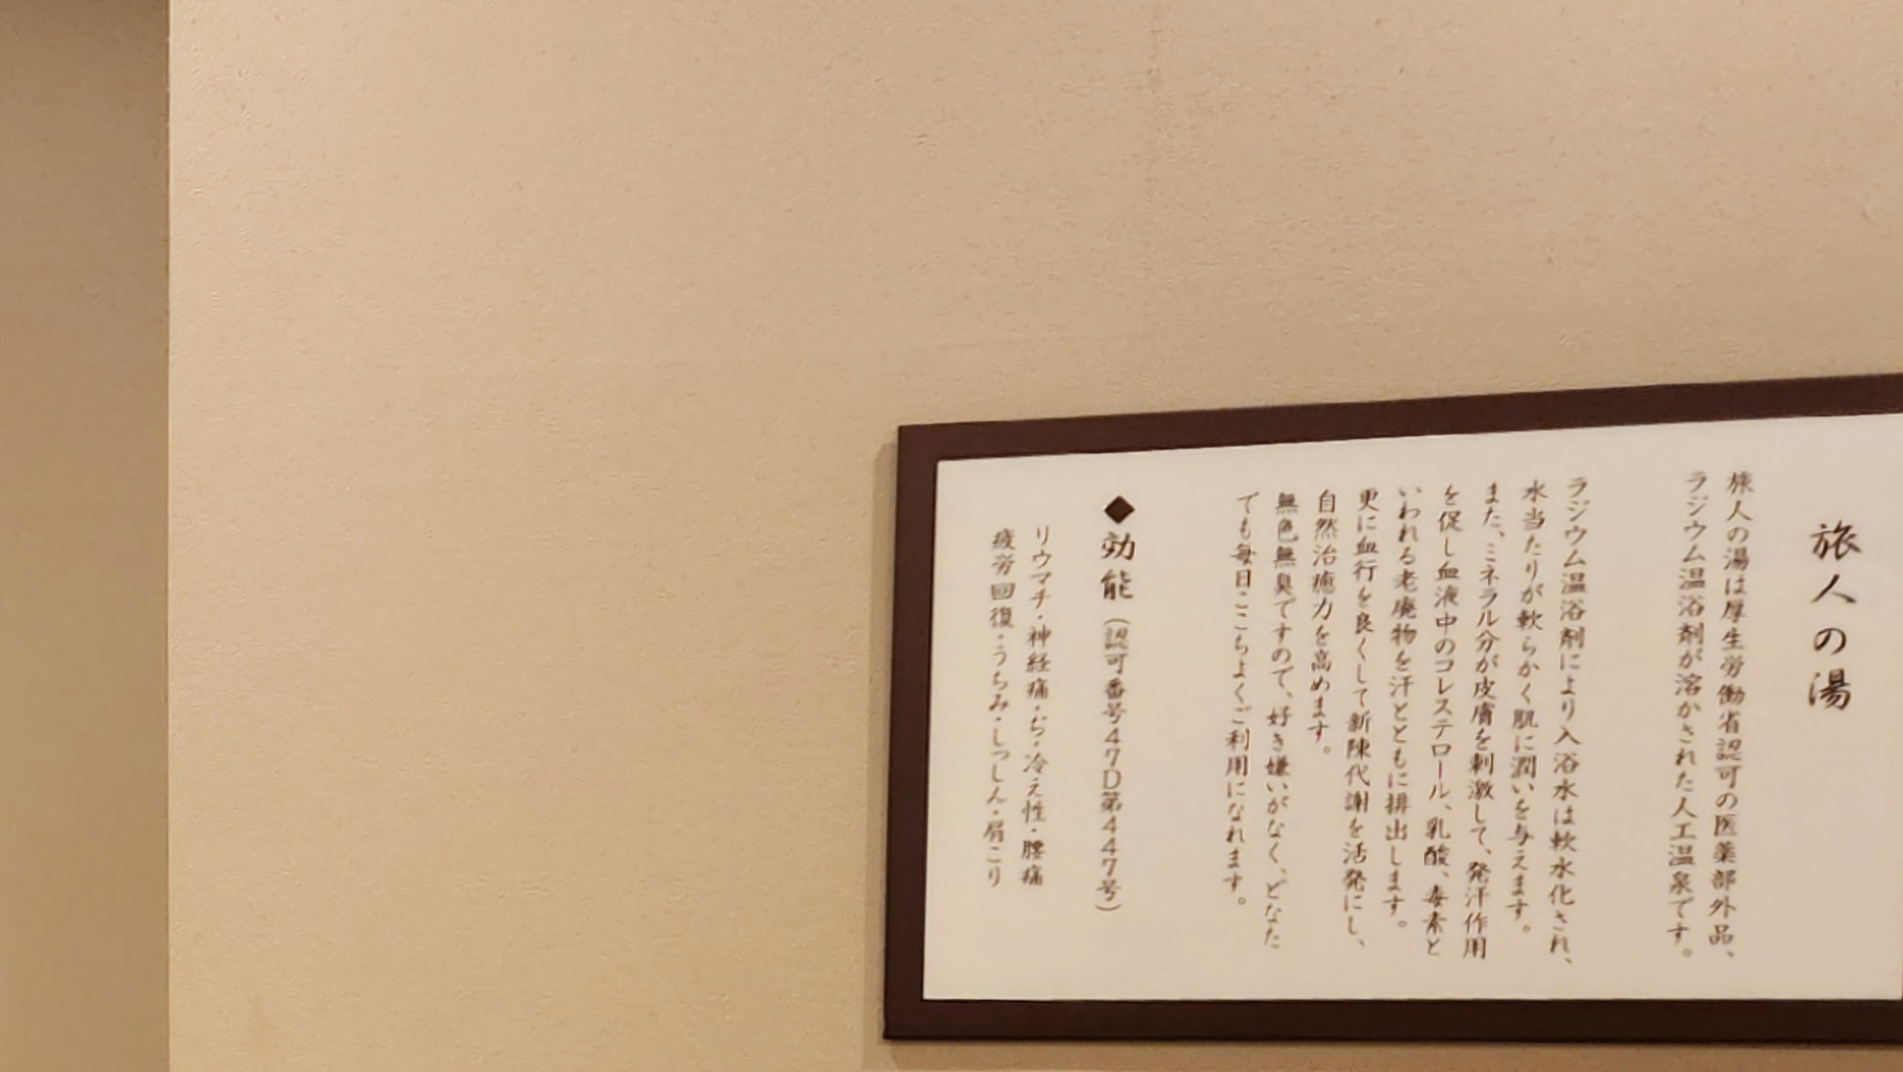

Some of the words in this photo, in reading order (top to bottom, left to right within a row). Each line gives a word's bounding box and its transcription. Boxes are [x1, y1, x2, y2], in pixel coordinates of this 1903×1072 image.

[1100, 530, 1136, 601] 効能
[1307, 488, 1339, 755] 自然治癒力を高めます。
[1342, 487, 1380, 947] 更に血行を良くして新陳代謝を活発にし、
[1505, 478, 1547, 934] 水当たりが軟らかく肌に潤いを与えます。
[1549, 475, 1591, 965] ラジウム温浴剤により入浴水は軟水化され、
[1666, 470, 1709, 959] ラジウム温浴剤が溶かされた人工温泉です。
[1708, 470, 1754, 959] 旅人の湯は厚生労働省認可の医薬部外品、
[1808, 519, 1863, 711] 旅人の湯
